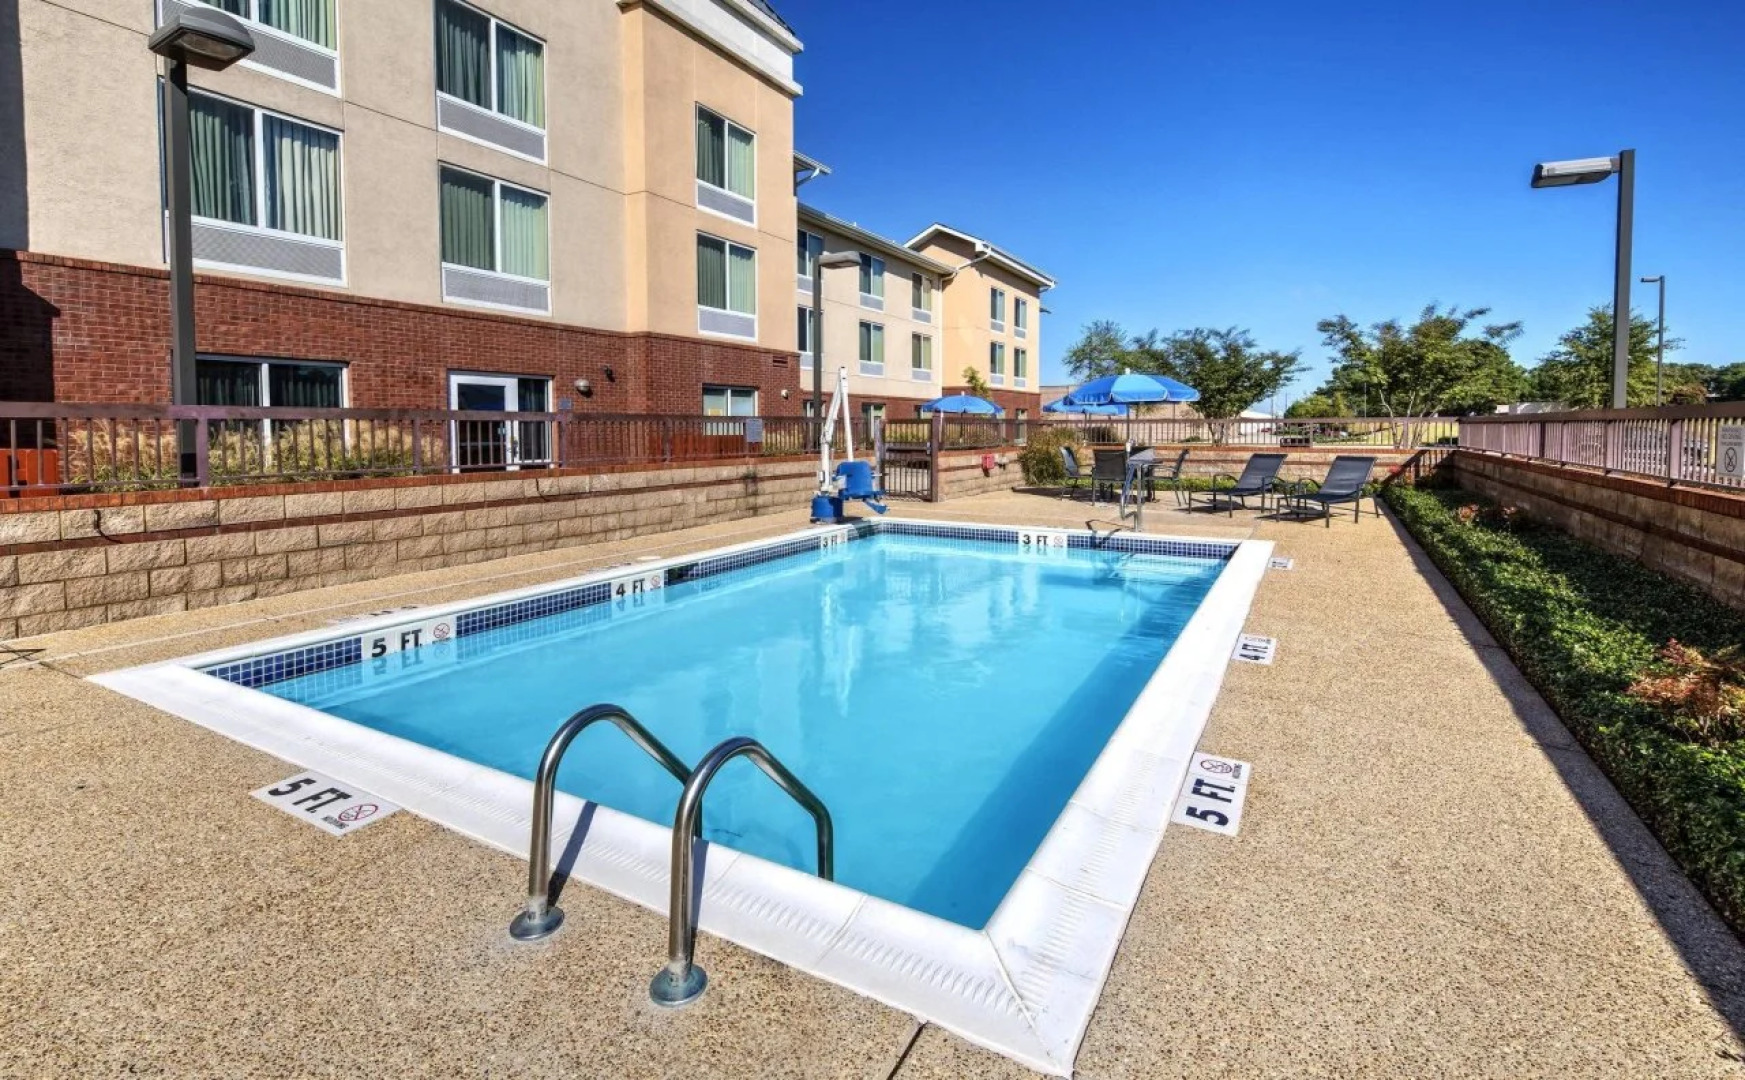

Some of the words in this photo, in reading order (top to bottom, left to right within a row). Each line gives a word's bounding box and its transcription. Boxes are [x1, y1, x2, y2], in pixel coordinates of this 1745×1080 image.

[1023, 534, 1031, 545] 3
[616, 583, 626, 597] 4
[371, 637, 387, 657] 5
[268, 778, 317, 796] 5
[1185, 806, 1229, 826] 5
